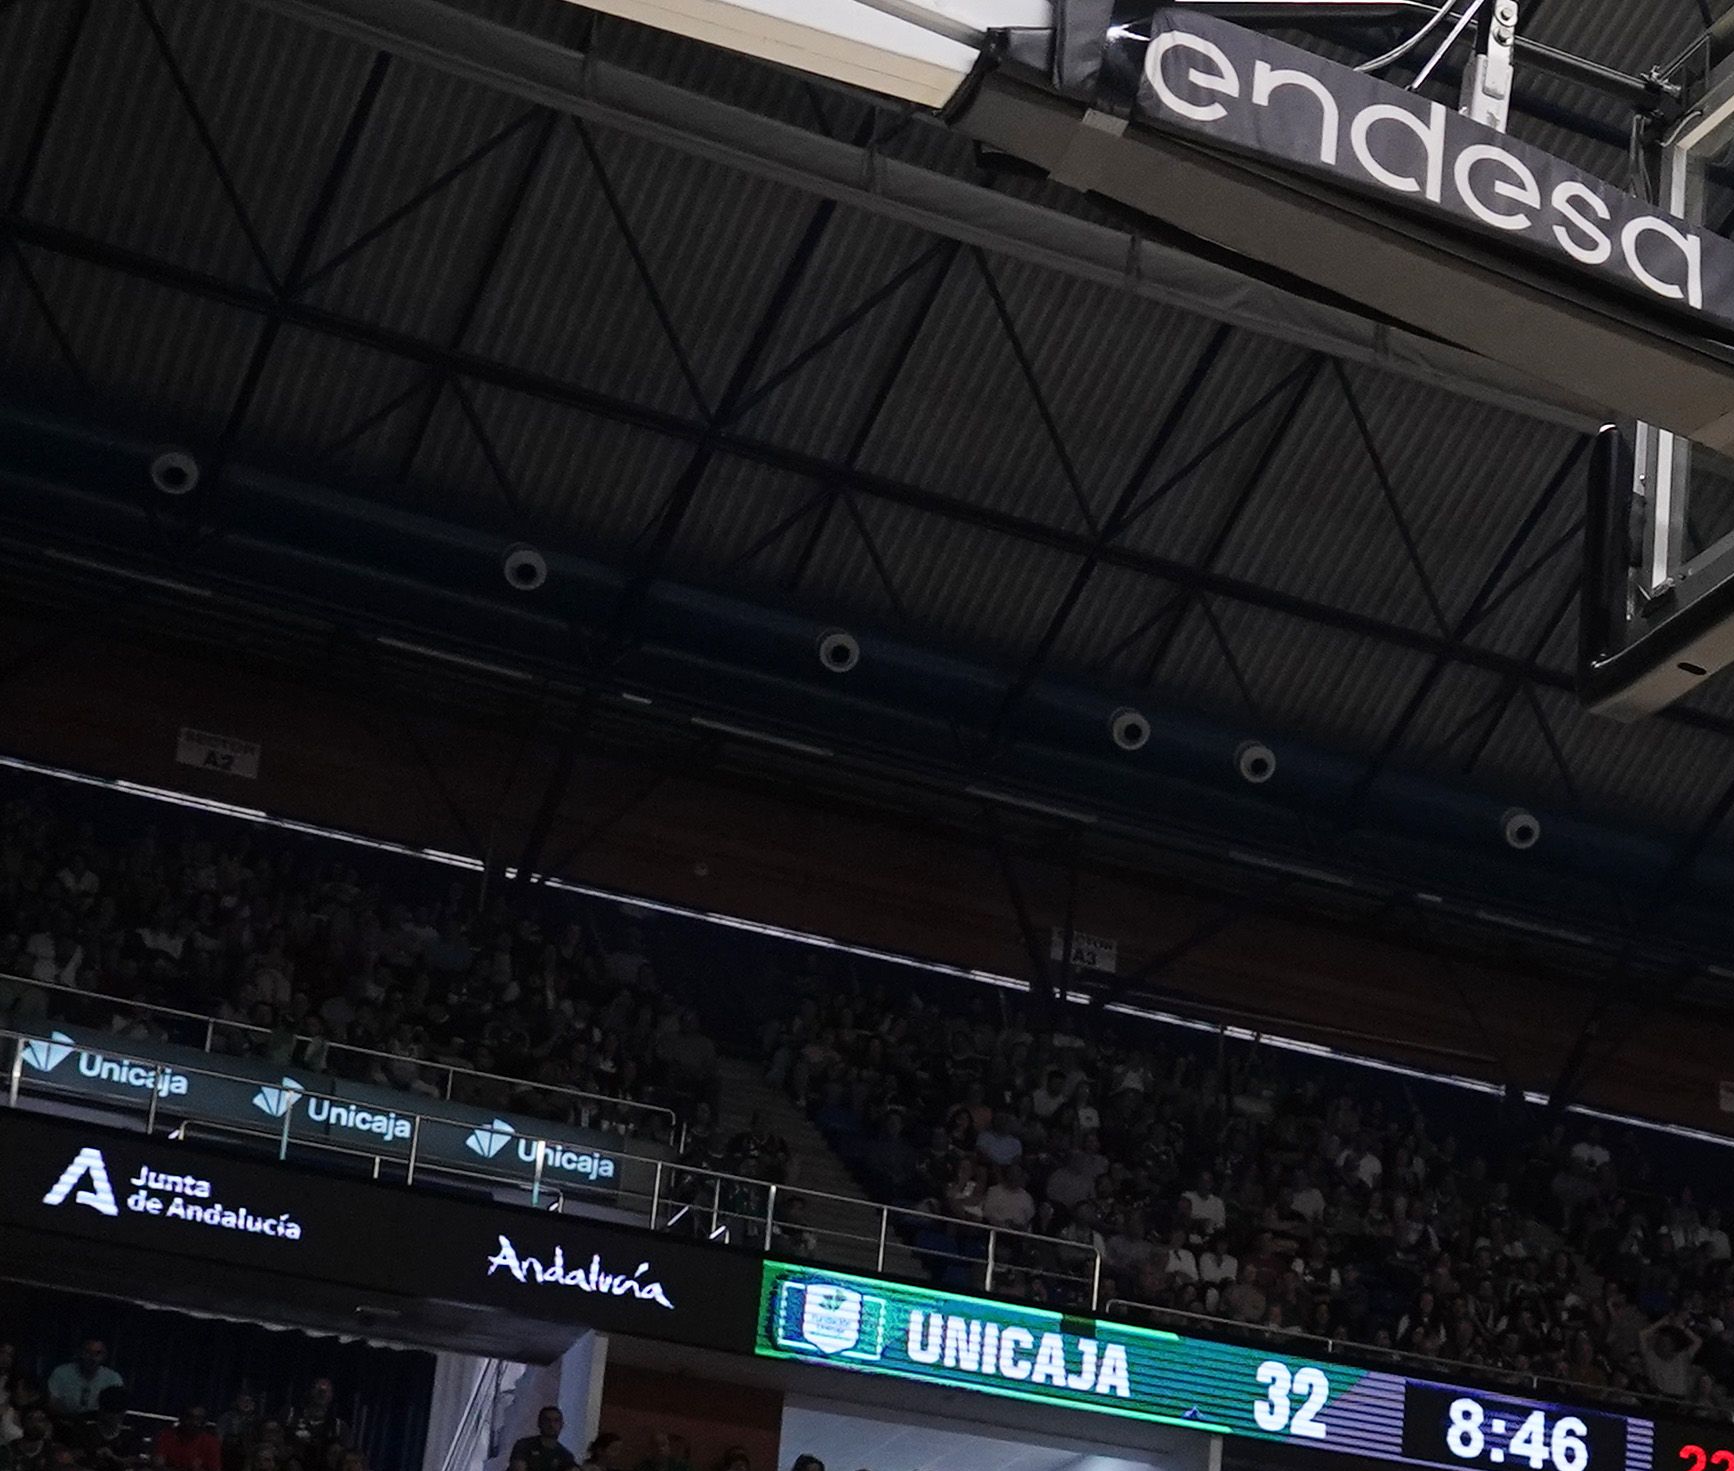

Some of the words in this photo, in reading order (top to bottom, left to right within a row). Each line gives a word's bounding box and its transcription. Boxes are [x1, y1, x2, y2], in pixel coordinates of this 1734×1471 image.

[1145, 29, 1704, 311] endesa
[78, 1049, 188, 1097] Unicaja
[308, 1096, 411, 1141] Unicaja
[131, 1165, 211, 1199] Junta
[518, 1137, 615, 1179] Unicaja
[127, 1190, 163, 1217] de
[165, 1197, 302, 1240] Andalucía
[488, 1235, 675, 1310] Andalucía
[907, 1309, 1131, 1399] UNICAJA
[1255, 1361, 1330, 1438] 32
